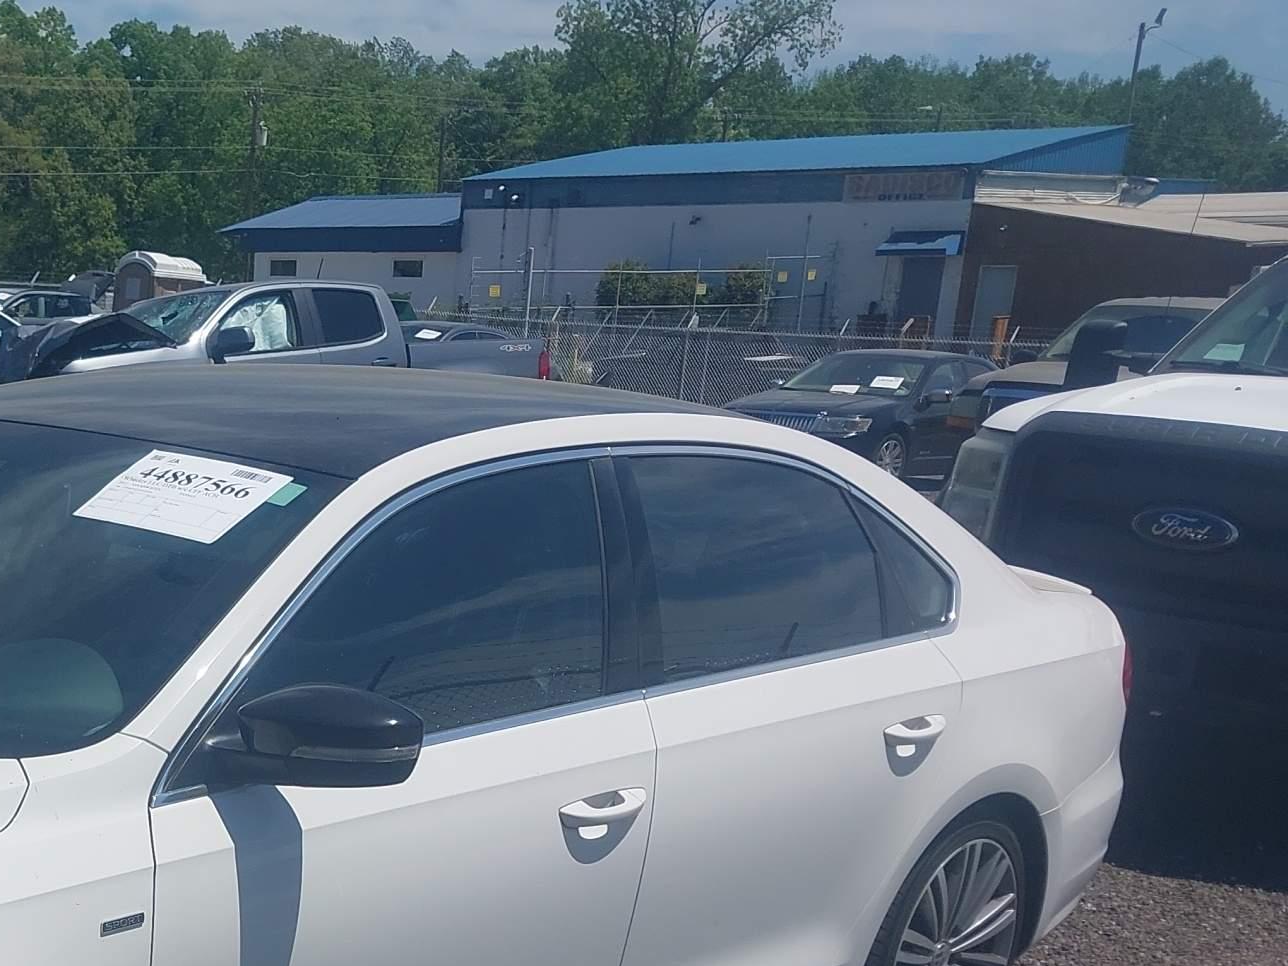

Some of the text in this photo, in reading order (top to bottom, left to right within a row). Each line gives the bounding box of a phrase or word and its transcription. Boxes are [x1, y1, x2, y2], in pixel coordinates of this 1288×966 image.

[139, 466, 257, 499] 44887566
[1152, 513, 1212, 541] Ford
[103, 914, 143, 931] SPORT
